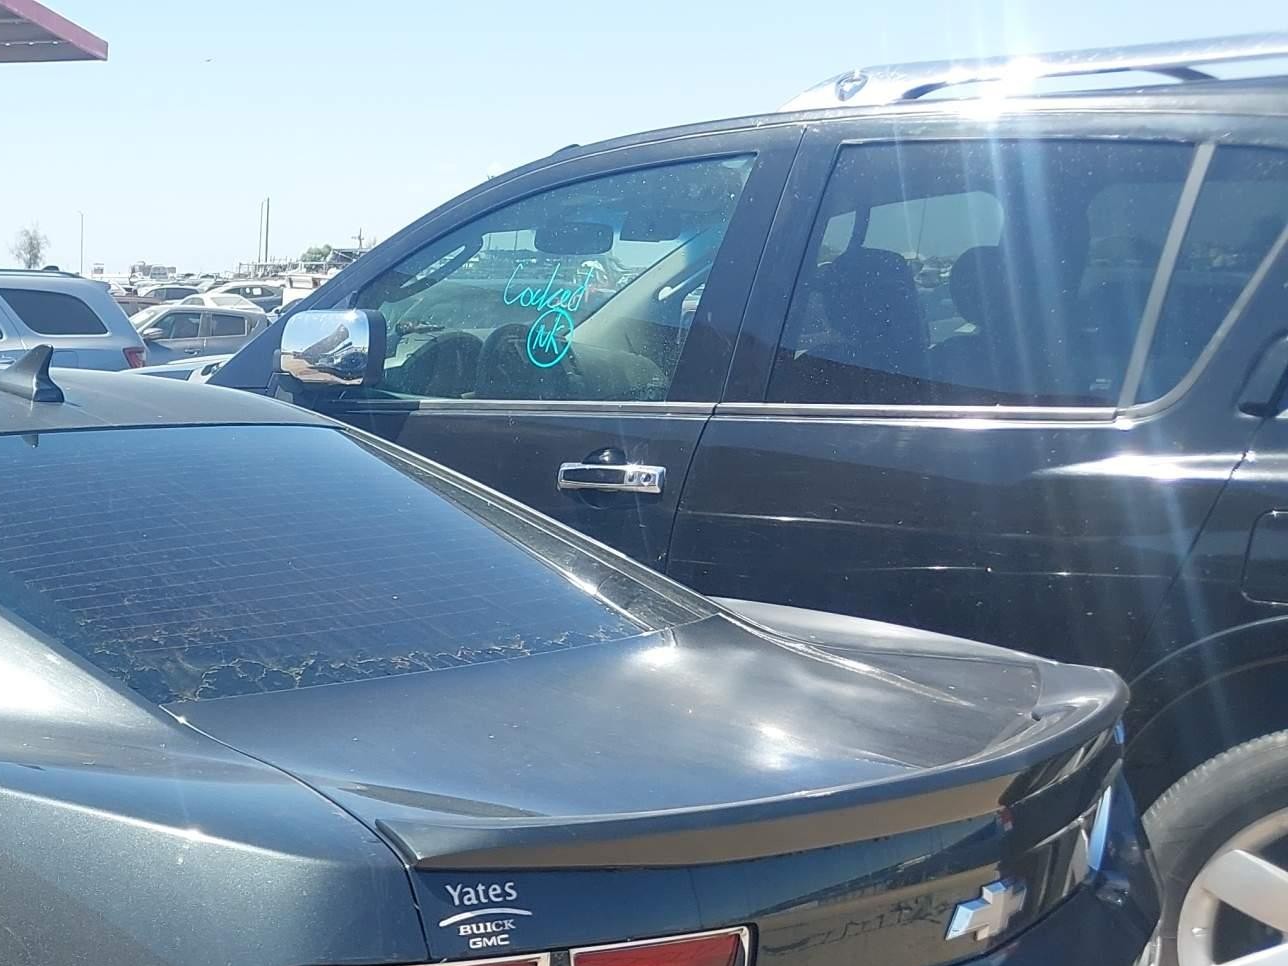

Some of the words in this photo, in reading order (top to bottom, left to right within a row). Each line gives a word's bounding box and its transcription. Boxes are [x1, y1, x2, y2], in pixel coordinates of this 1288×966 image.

[445, 882, 518, 906] Yates
[458, 919, 516, 936] BUICK
[469, 934, 510, 949] GMC
